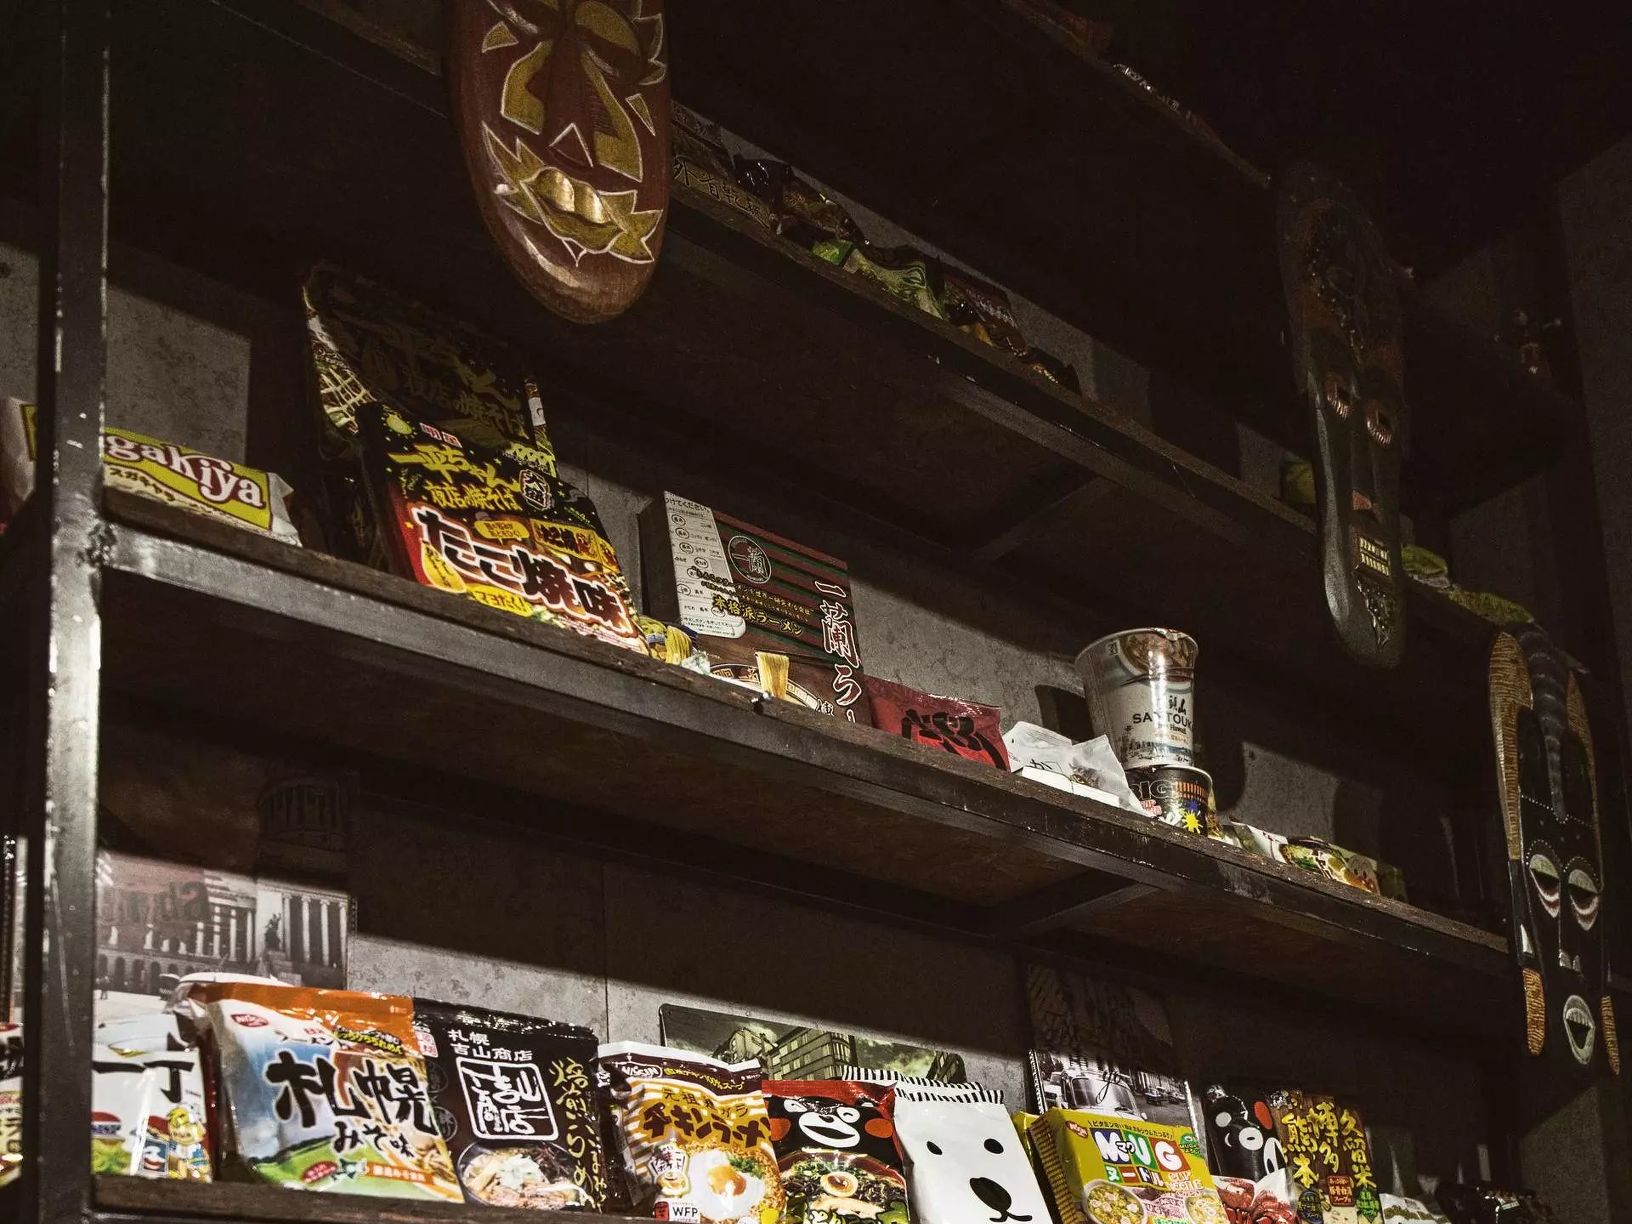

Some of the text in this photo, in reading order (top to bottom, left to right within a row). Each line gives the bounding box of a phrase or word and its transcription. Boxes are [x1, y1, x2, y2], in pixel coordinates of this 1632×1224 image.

[447, 1029, 490, 1046] 札幌
[450, 1042, 533, 1062] 吉山商店
[265, 1051, 438, 1136] 札幌
[334, 1121, 415, 1159] みそ味
[1094, 1131, 1183, 1171] MUG
[672, 1206, 699, 1218] WFP
